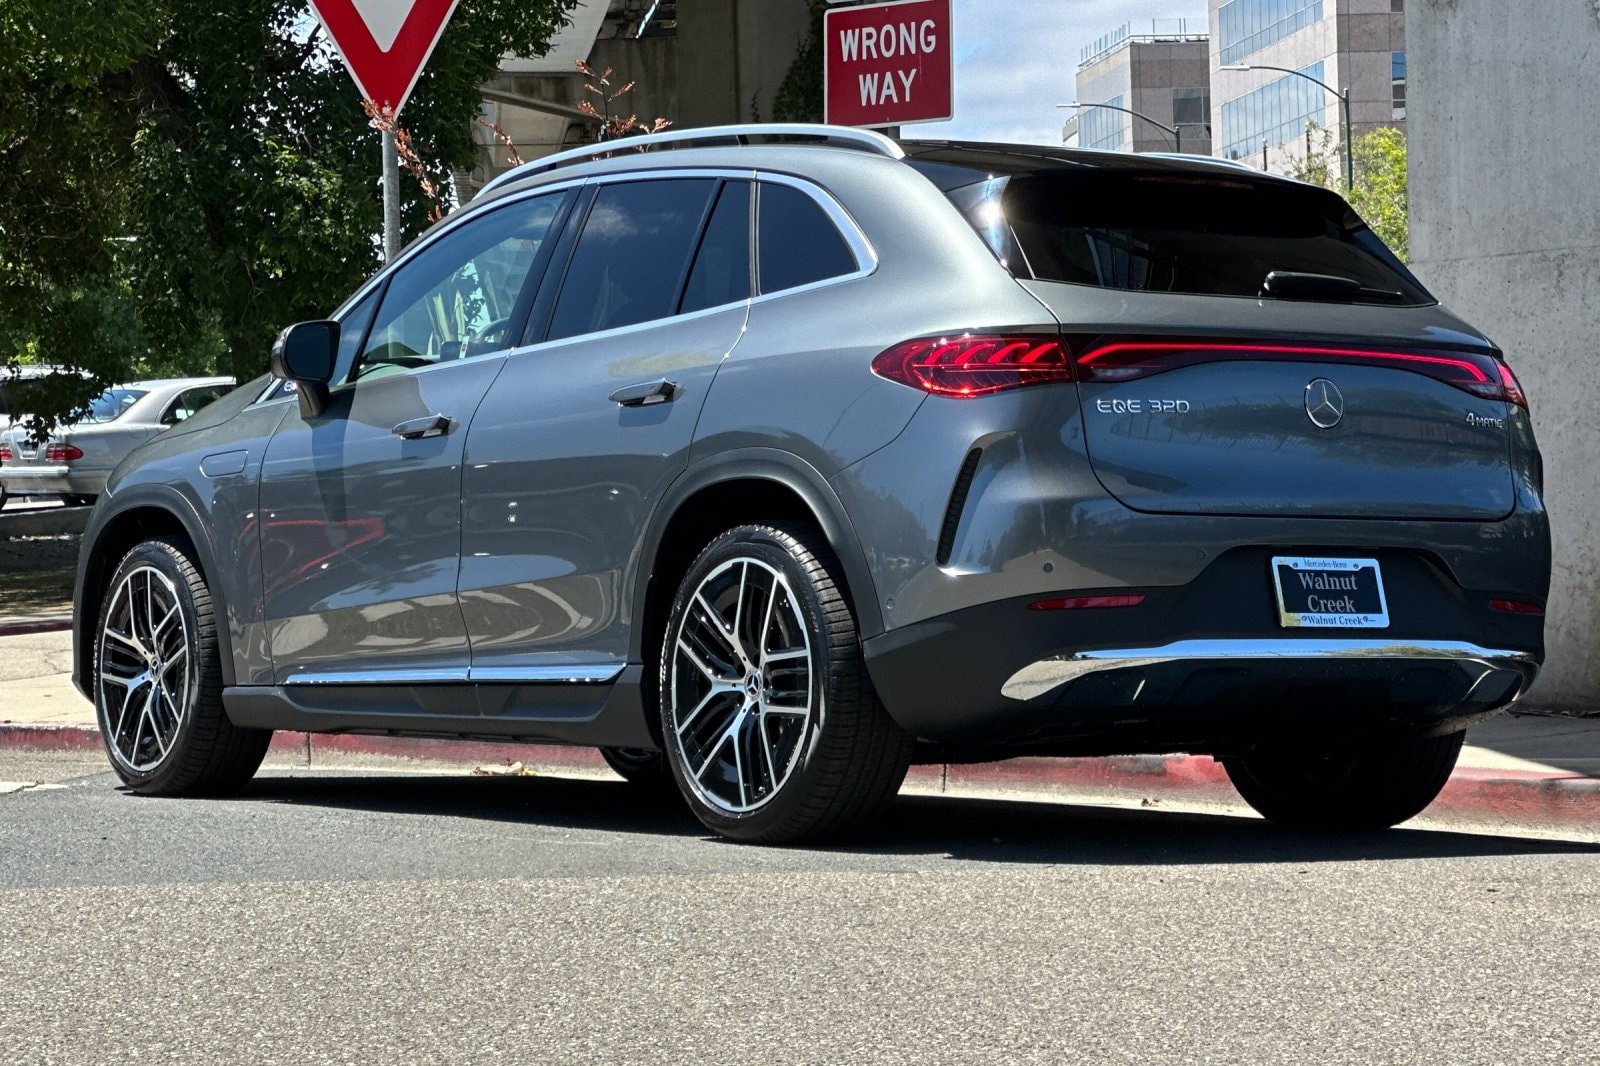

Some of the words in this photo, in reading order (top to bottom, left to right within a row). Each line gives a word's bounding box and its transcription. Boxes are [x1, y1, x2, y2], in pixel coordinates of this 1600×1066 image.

[840, 19, 936, 62] WRONG
[858, 68, 917, 107] WAY
[1096, 399, 1141, 413] EQE
[1148, 399, 1190, 413] 320
[1465, 412, 1504, 429] 4MATIC
[1303, 559, 1348, 568] Mercedes-Benz
[1297, 572, 1358, 590] Walnut
[1307, 594, 1356, 613] Creek
[1308, 616, 1337, 625] Walnut
[1338, 616, 1363, 625] Creek
